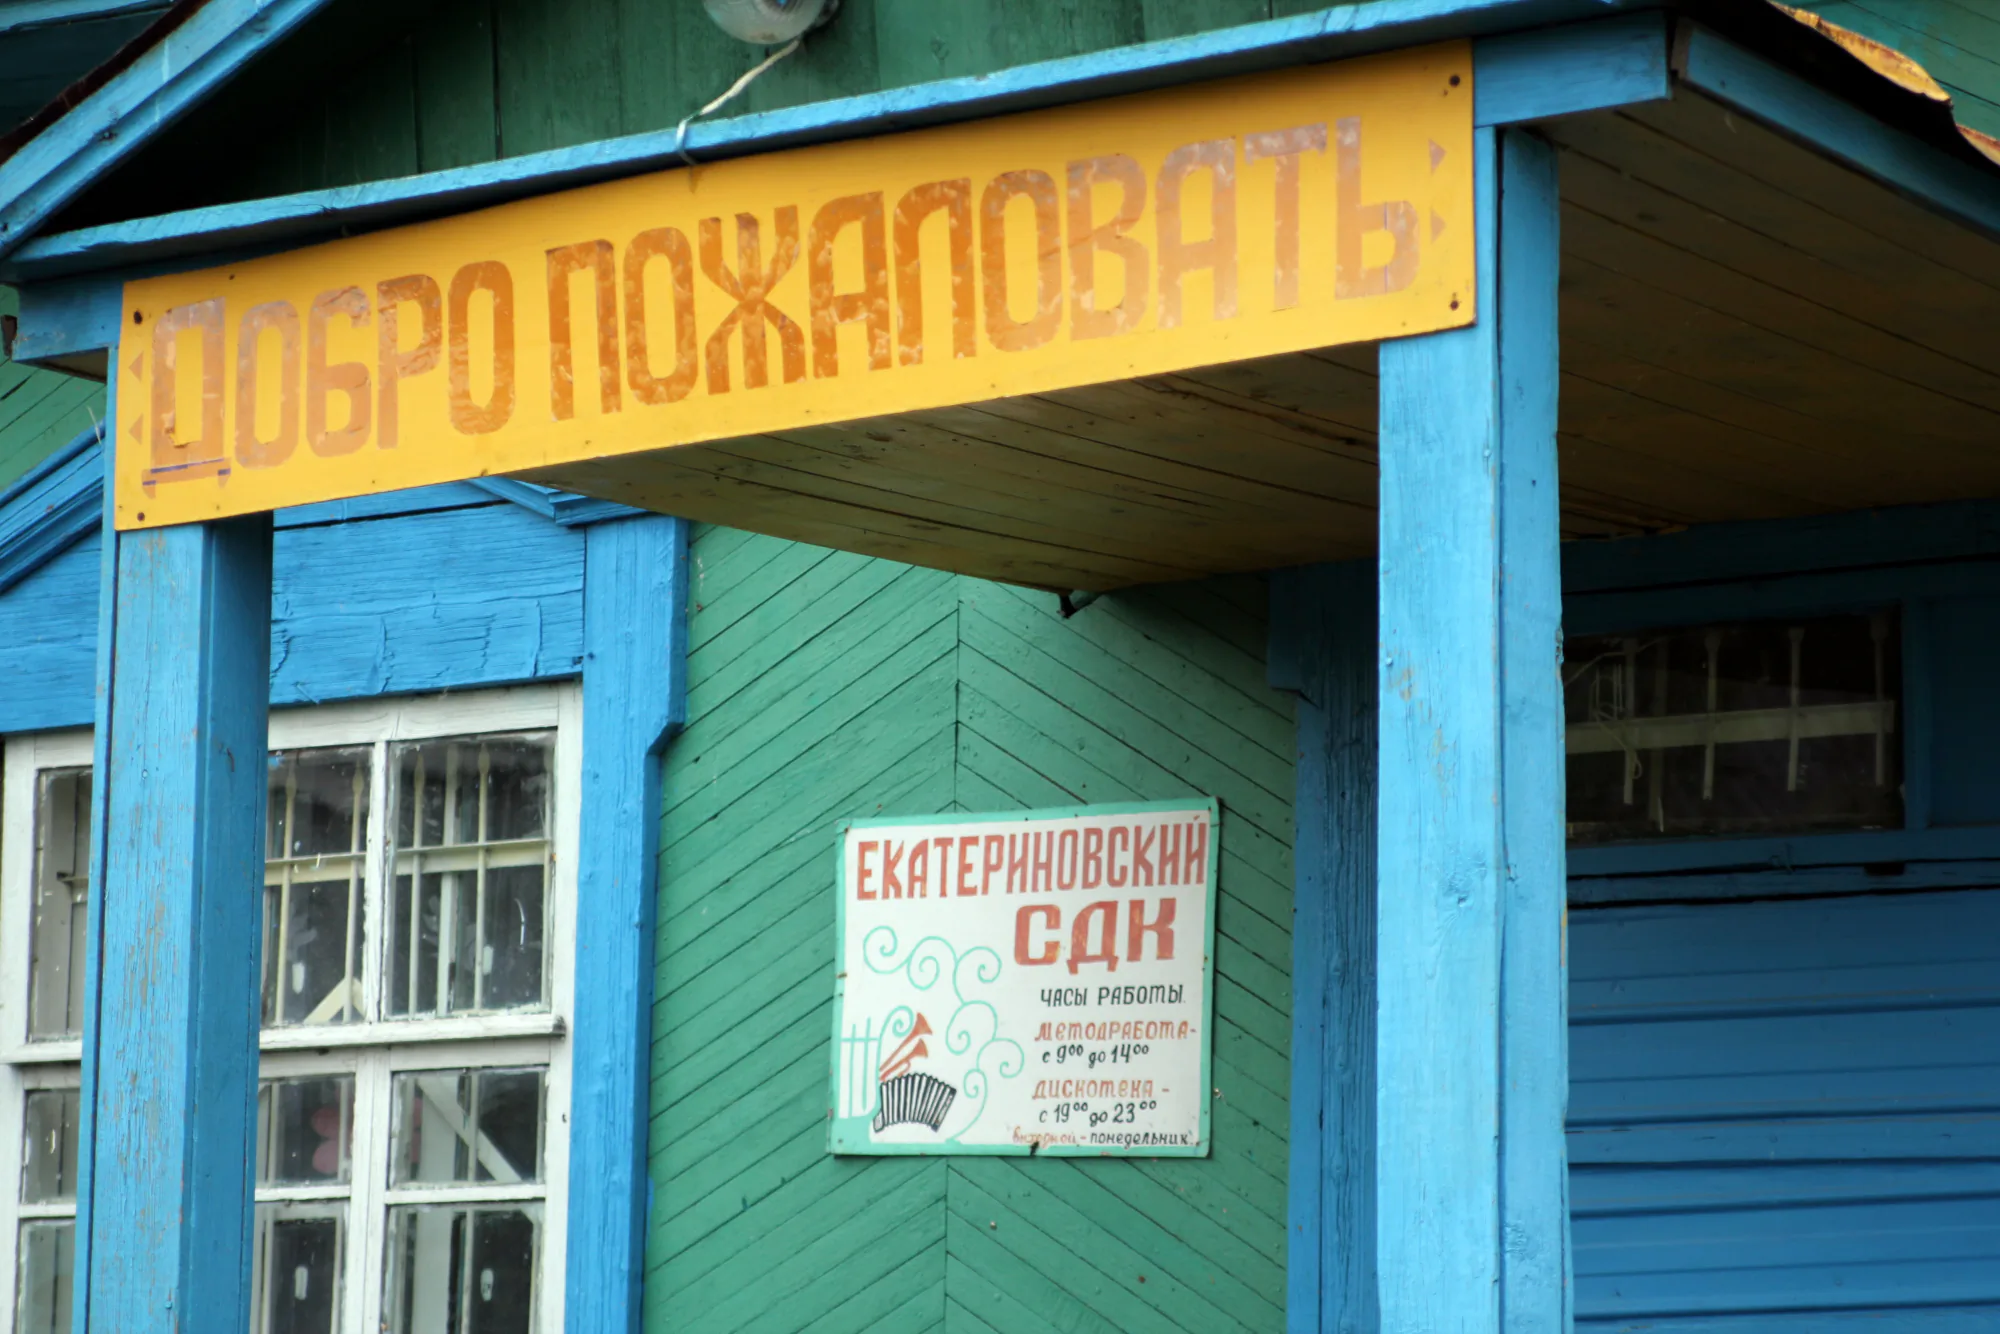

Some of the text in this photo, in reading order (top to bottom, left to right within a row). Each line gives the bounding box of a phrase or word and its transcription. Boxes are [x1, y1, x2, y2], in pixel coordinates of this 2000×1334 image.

[141, 115, 1421, 500] ДОБРО ПОЖАЛОВАТЬ
[856, 816, 1207, 901] ЕКАТЕРИНОВСКИЙ
[1013, 897, 1178, 976] СДК
[1040, 987, 1088, 1007] ЧАСЫ
